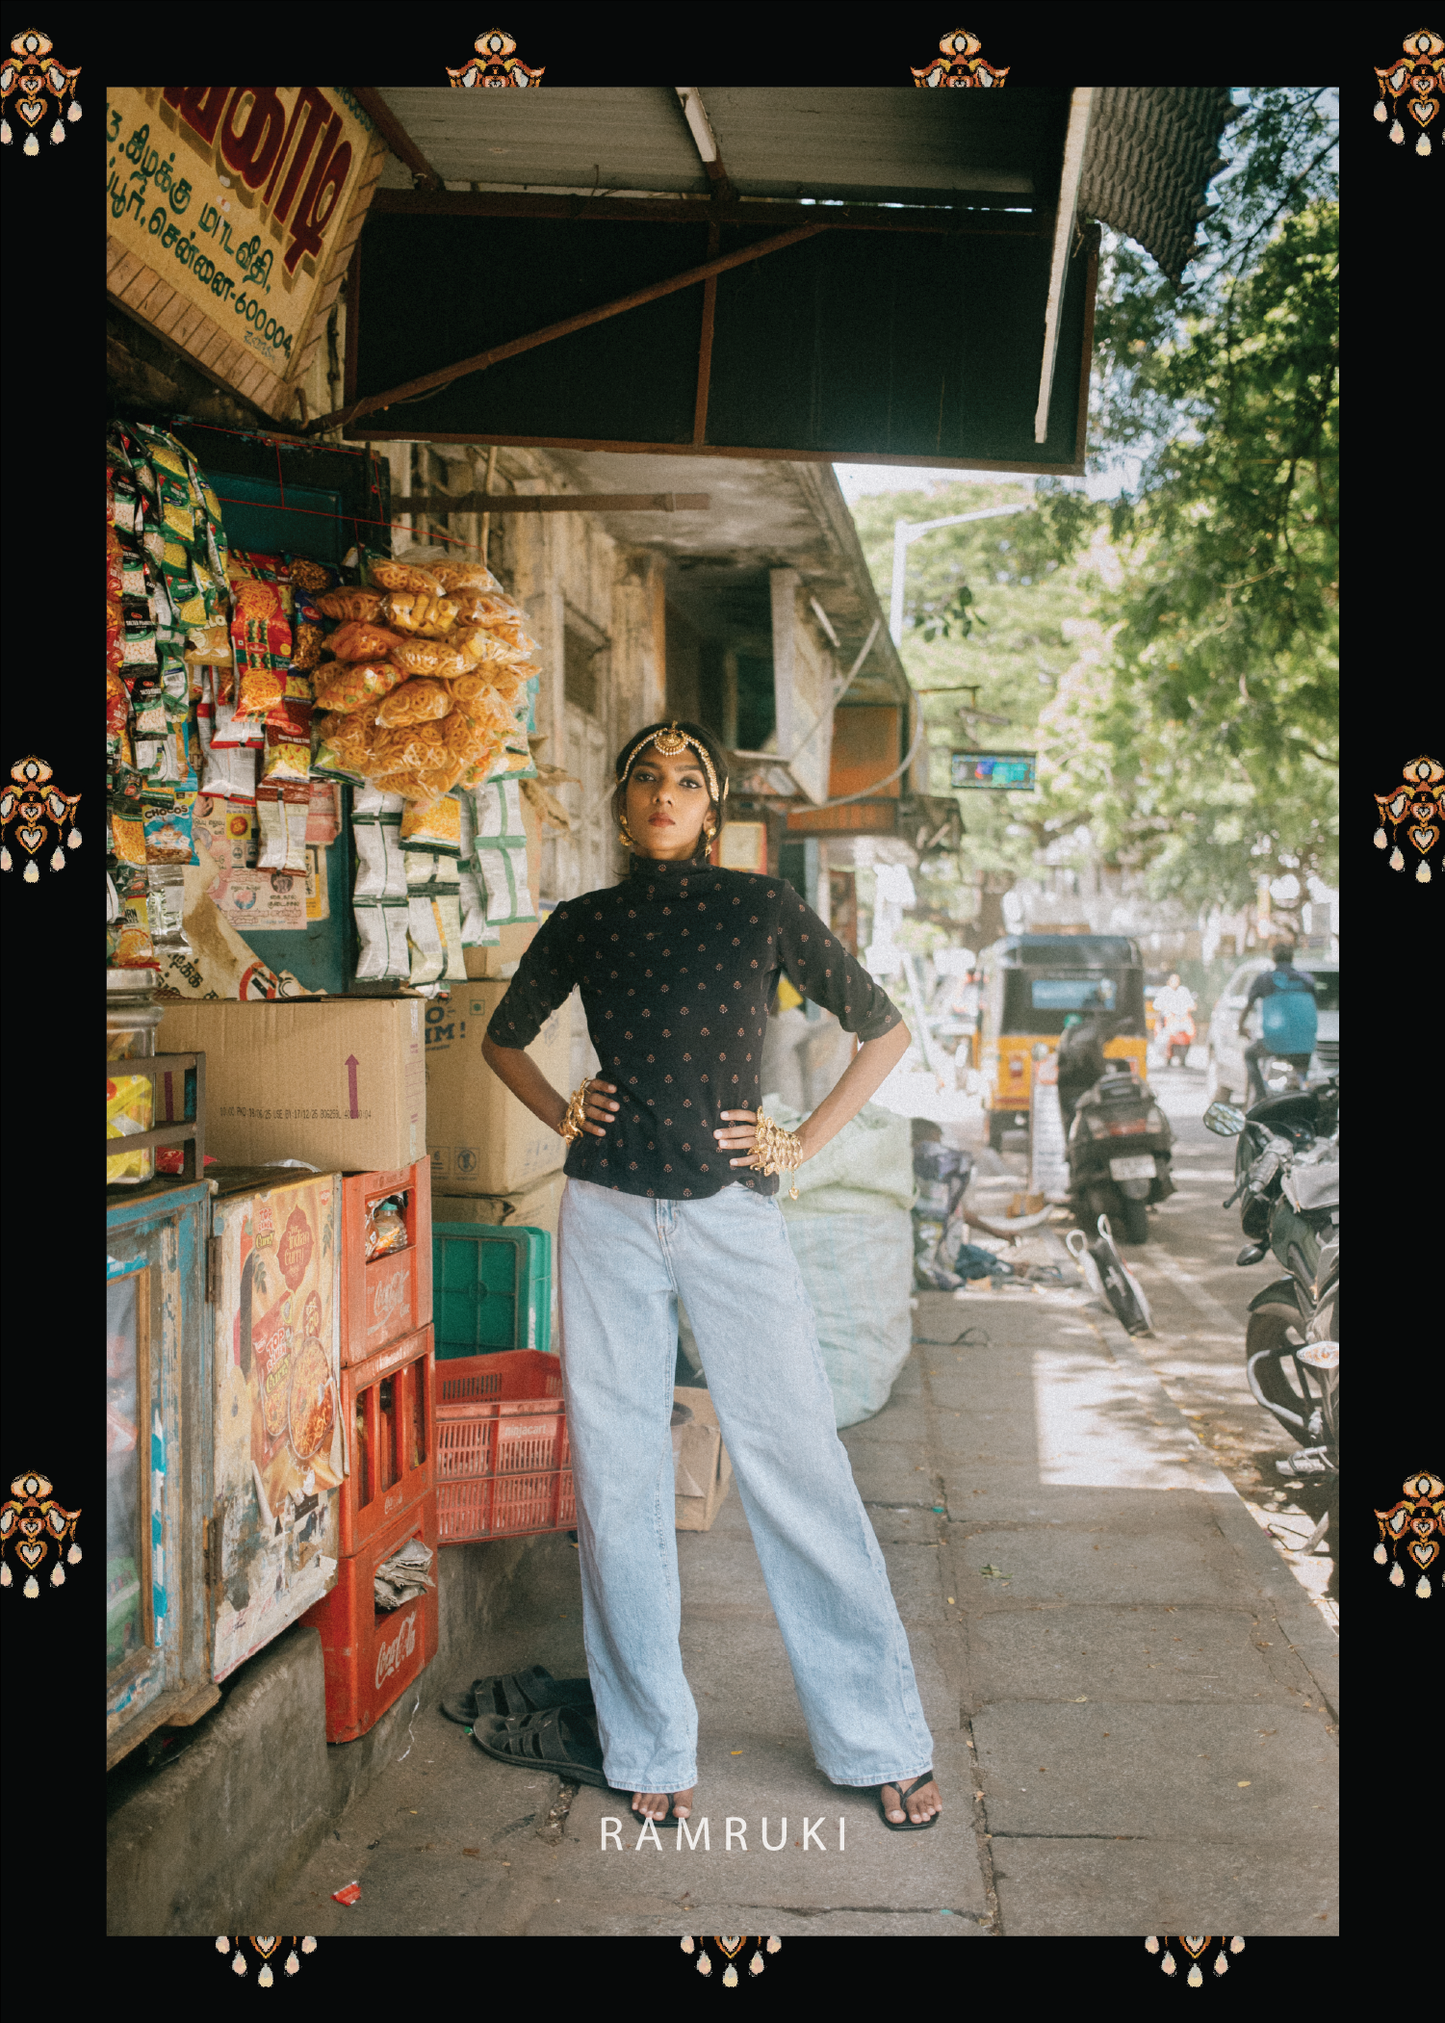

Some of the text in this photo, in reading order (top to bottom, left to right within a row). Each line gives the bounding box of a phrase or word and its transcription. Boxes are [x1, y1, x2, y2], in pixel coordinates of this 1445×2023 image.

[144, 804, 189, 820] CHOCOS
[259, 1207, 273, 1221] TOP
[266, 1327, 285, 1357] TOP
[504, 1423, 547, 1438] ninjacart
